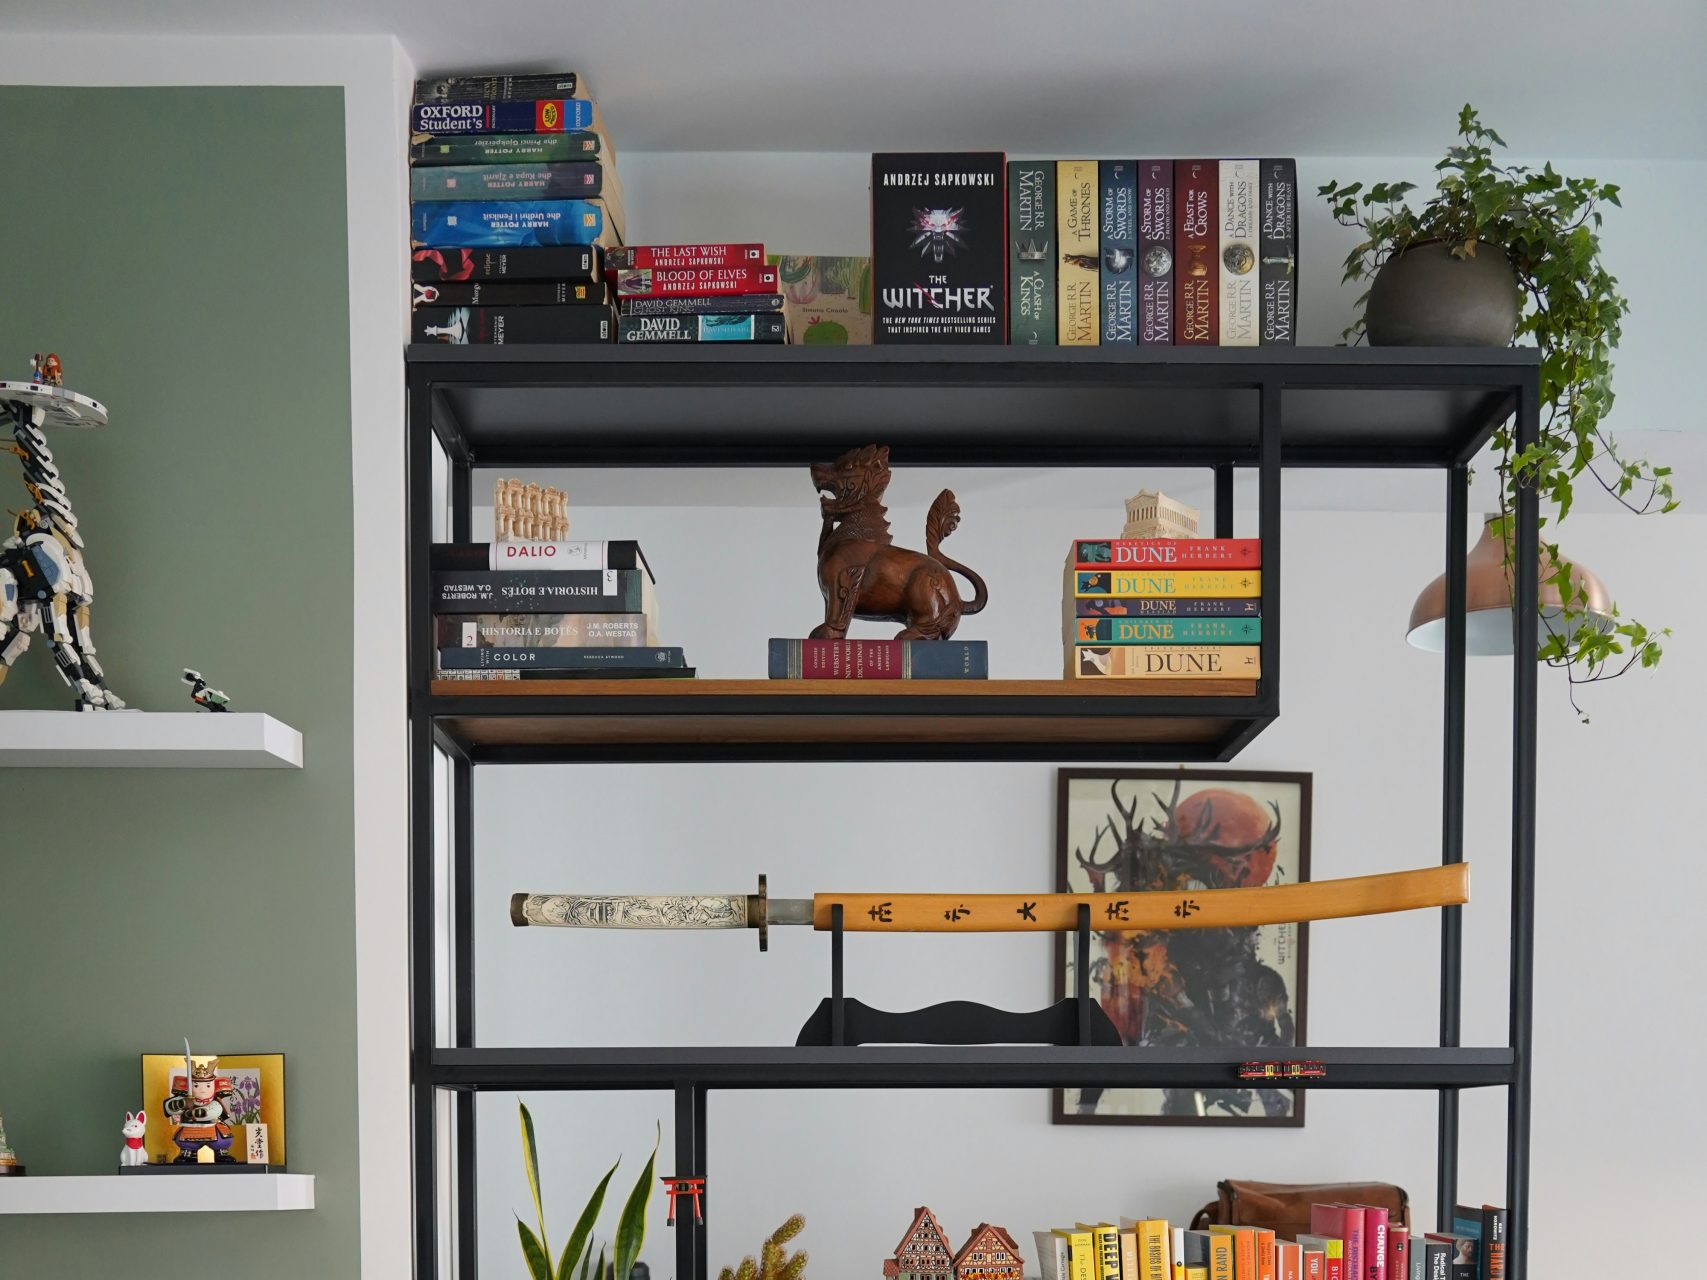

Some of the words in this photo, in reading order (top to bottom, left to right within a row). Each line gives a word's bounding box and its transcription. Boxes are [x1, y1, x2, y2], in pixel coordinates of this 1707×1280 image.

[420, 106, 482, 118] OXFORD
[420, 118, 482, 130] Student's
[883, 173, 930, 186] ANDRZEJ
[934, 173, 994, 186] SAPKOWSKI
[1034, 170, 1044, 210] GEORGE
[1019, 170, 1034, 231] MARTIN
[1078, 182, 1091, 242] THRONES
[1114, 187, 1127, 240] SWORDS
[1152, 187, 1165, 241] SWORDS
[1194, 191, 1208, 237] CROWS
[1234, 180, 1246, 240] DRAGONS
[1272, 182, 1286, 240] DRAGONS
[650, 248, 672, 257] THE
[674, 246, 697, 256] LAST
[700, 246, 727, 256] WISH
[656, 270, 696, 282] BLOOD
[699, 270, 715, 281] OF
[717, 268, 747, 280] ELVES
[928, 274, 948, 284] THE
[663, 282, 695, 290] ANDRZEJ
[699, 281, 737, 290] SAPKOWSKI
[882, 287, 995, 312] WITCHER
[1020, 276, 1034, 316] KINGS
[1078, 281, 1092, 342] MARTIN
[1117, 280, 1132, 342] MARTIN
[1154, 280, 1169, 342] MARTIN
[1194, 280, 1209, 340] MARTIN
[1236, 280, 1251, 340] MARTIN
[1274, 280, 1290, 342] MARTIN
[640, 318, 680, 332] DAVID
[626, 330, 692, 342] GEMMELL
[506, 546, 556, 558] DALIO
[1116, 546, 1178, 563] DUNE
[444, 584, 473, 592] WESTAD
[476, 584, 492, 592] O.A.
[502, 586, 536, 598] BOTËS
[539, 586, 545, 596] E
[547, 586, 598, 596] HISTORIA
[1116, 578, 1176, 594] DUNE
[442, 592, 477, 600] ROBERTS
[480, 592, 494, 600] J.M.
[1140, 600, 1176, 611] DUNE
[481, 626, 533, 636] HISTORIA
[534, 626, 542, 636] E
[588, 630, 604, 638] O.A.
[604, 630, 638, 638] WESTAD
[602, 622, 639, 630] ROBERTS
[1119, 624, 1174, 640] DUNE
[493, 652, 536, 662] COLOR
[1144, 653, 1222, 672] DUNE
[1104, 1233, 1118, 1269] DEEP
[1376, 1224, 1386, 1268] CHANGE
[1216, 1246, 1228, 1272] RAND
[1310, 1258, 1319, 1274] YOU
[1370, 1266, 1378, 1280] BY
